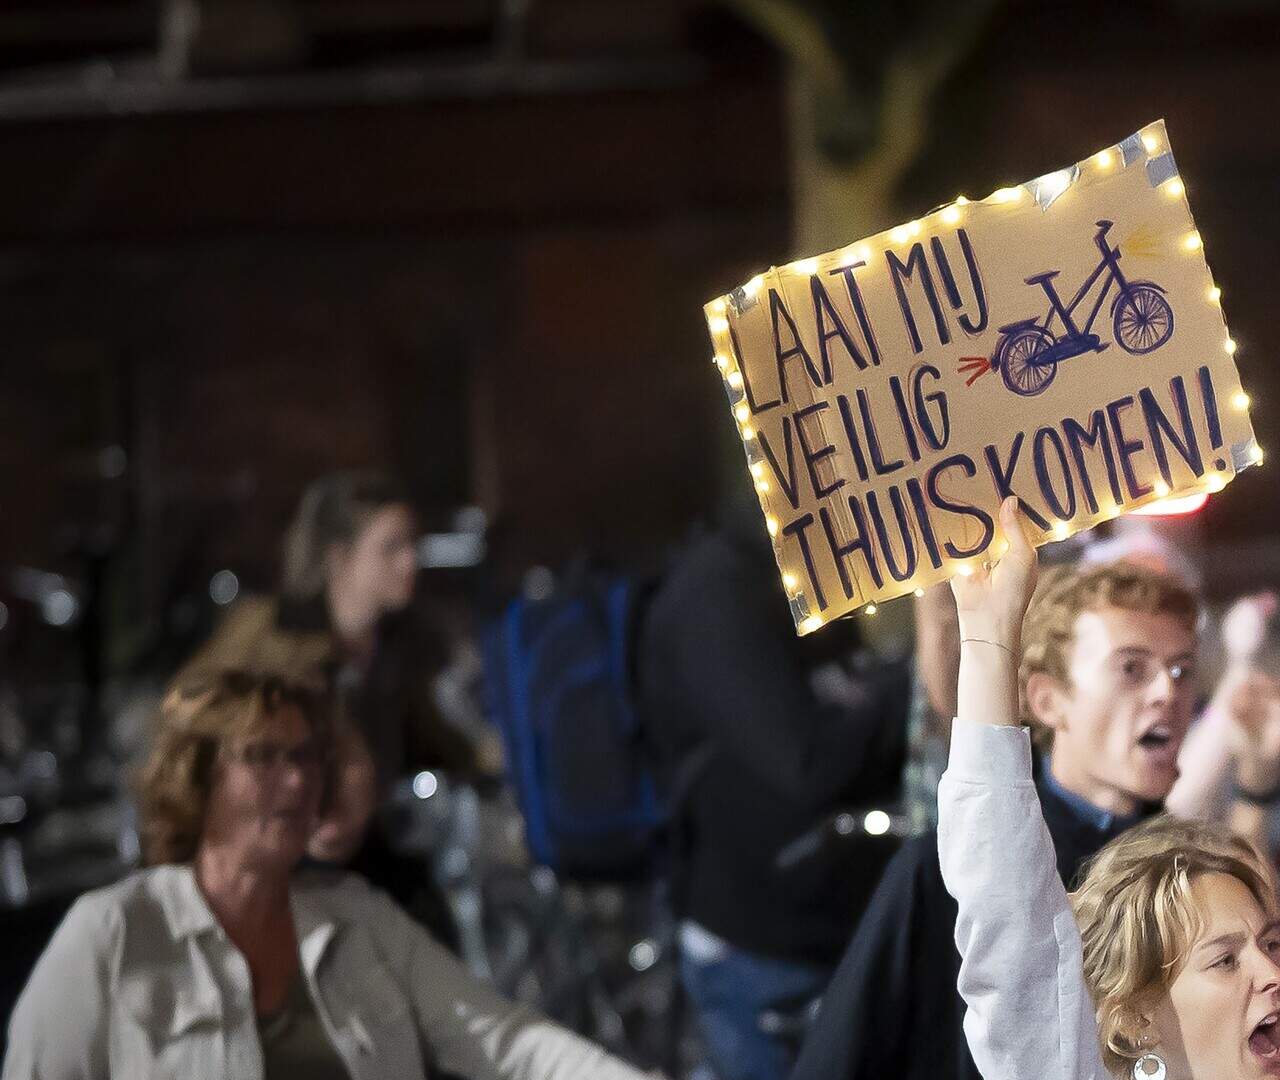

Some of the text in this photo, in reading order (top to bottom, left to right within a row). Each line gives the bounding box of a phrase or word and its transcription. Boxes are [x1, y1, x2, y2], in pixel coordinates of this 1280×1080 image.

[727, 228, 991, 416] LAAT MIJ
[757, 365, 951, 510] VEILIG
